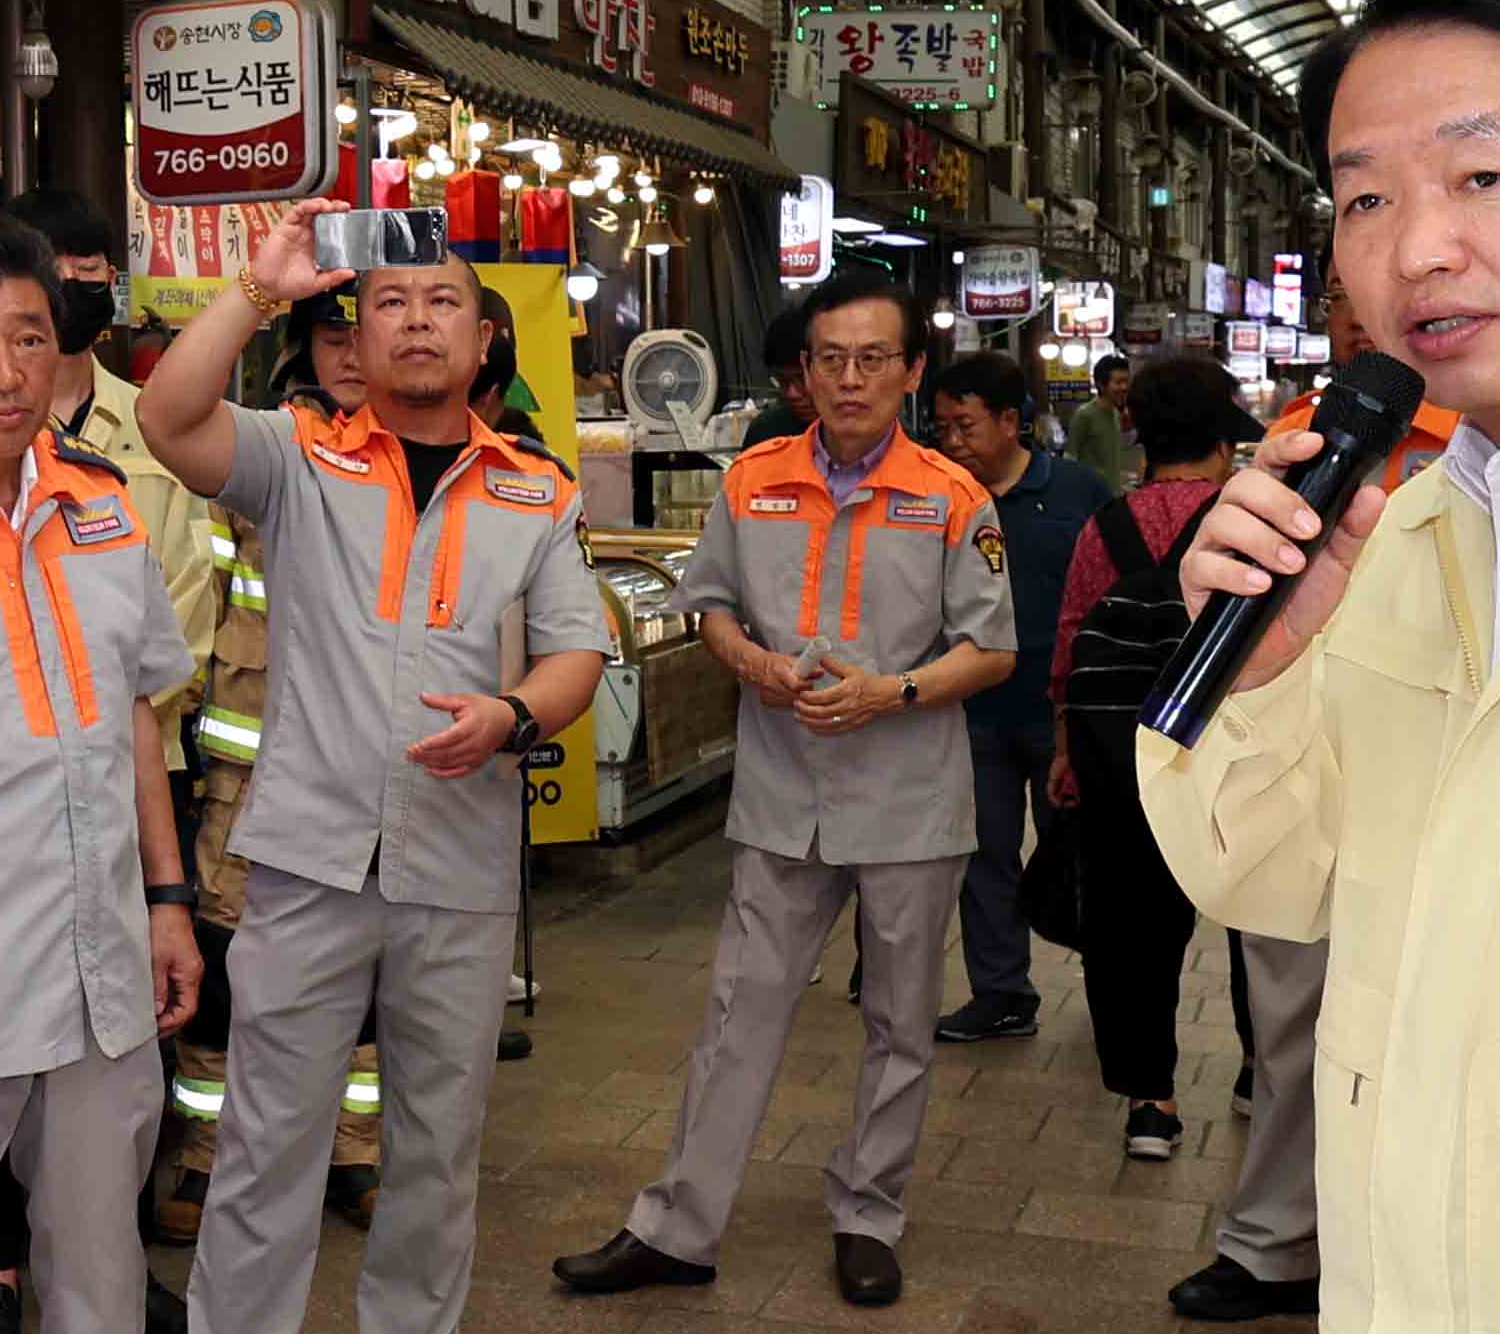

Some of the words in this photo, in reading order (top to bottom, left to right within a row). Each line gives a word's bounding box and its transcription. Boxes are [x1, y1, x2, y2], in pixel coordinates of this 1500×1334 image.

[180, 22, 243, 45] 송현시장
[961, 29, 987, 78] 국밥
[144, 61, 296, 114] 해뜨는식품
[153, 141, 289, 176] 766-0960
